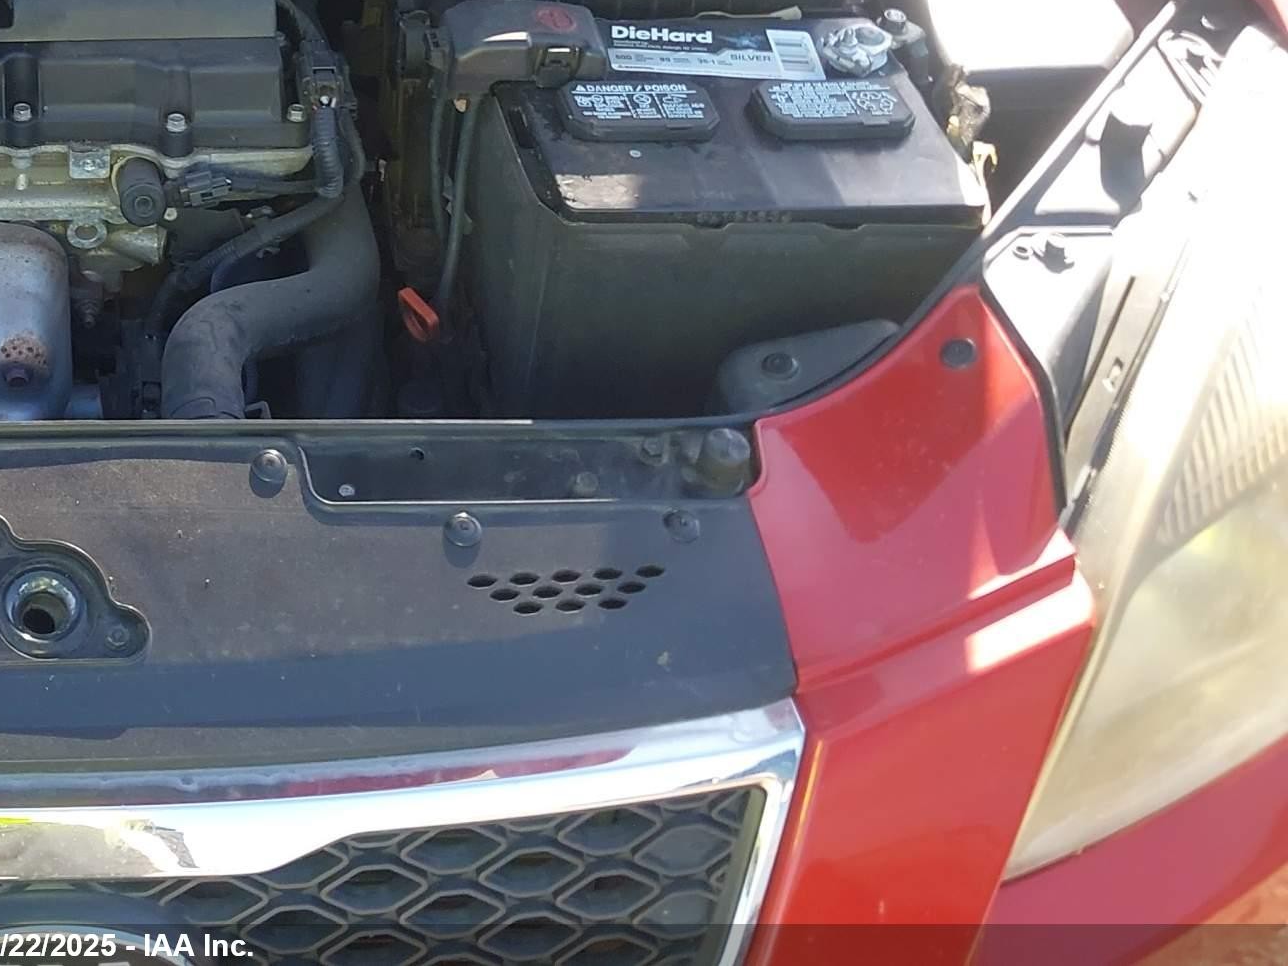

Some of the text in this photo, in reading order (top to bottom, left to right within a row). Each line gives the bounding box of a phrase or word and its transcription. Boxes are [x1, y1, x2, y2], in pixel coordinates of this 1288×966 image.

[611, 25, 713, 44] DieHard
[586, 84, 634, 92] DANGER
[643, 83, 688, 92] POISON
